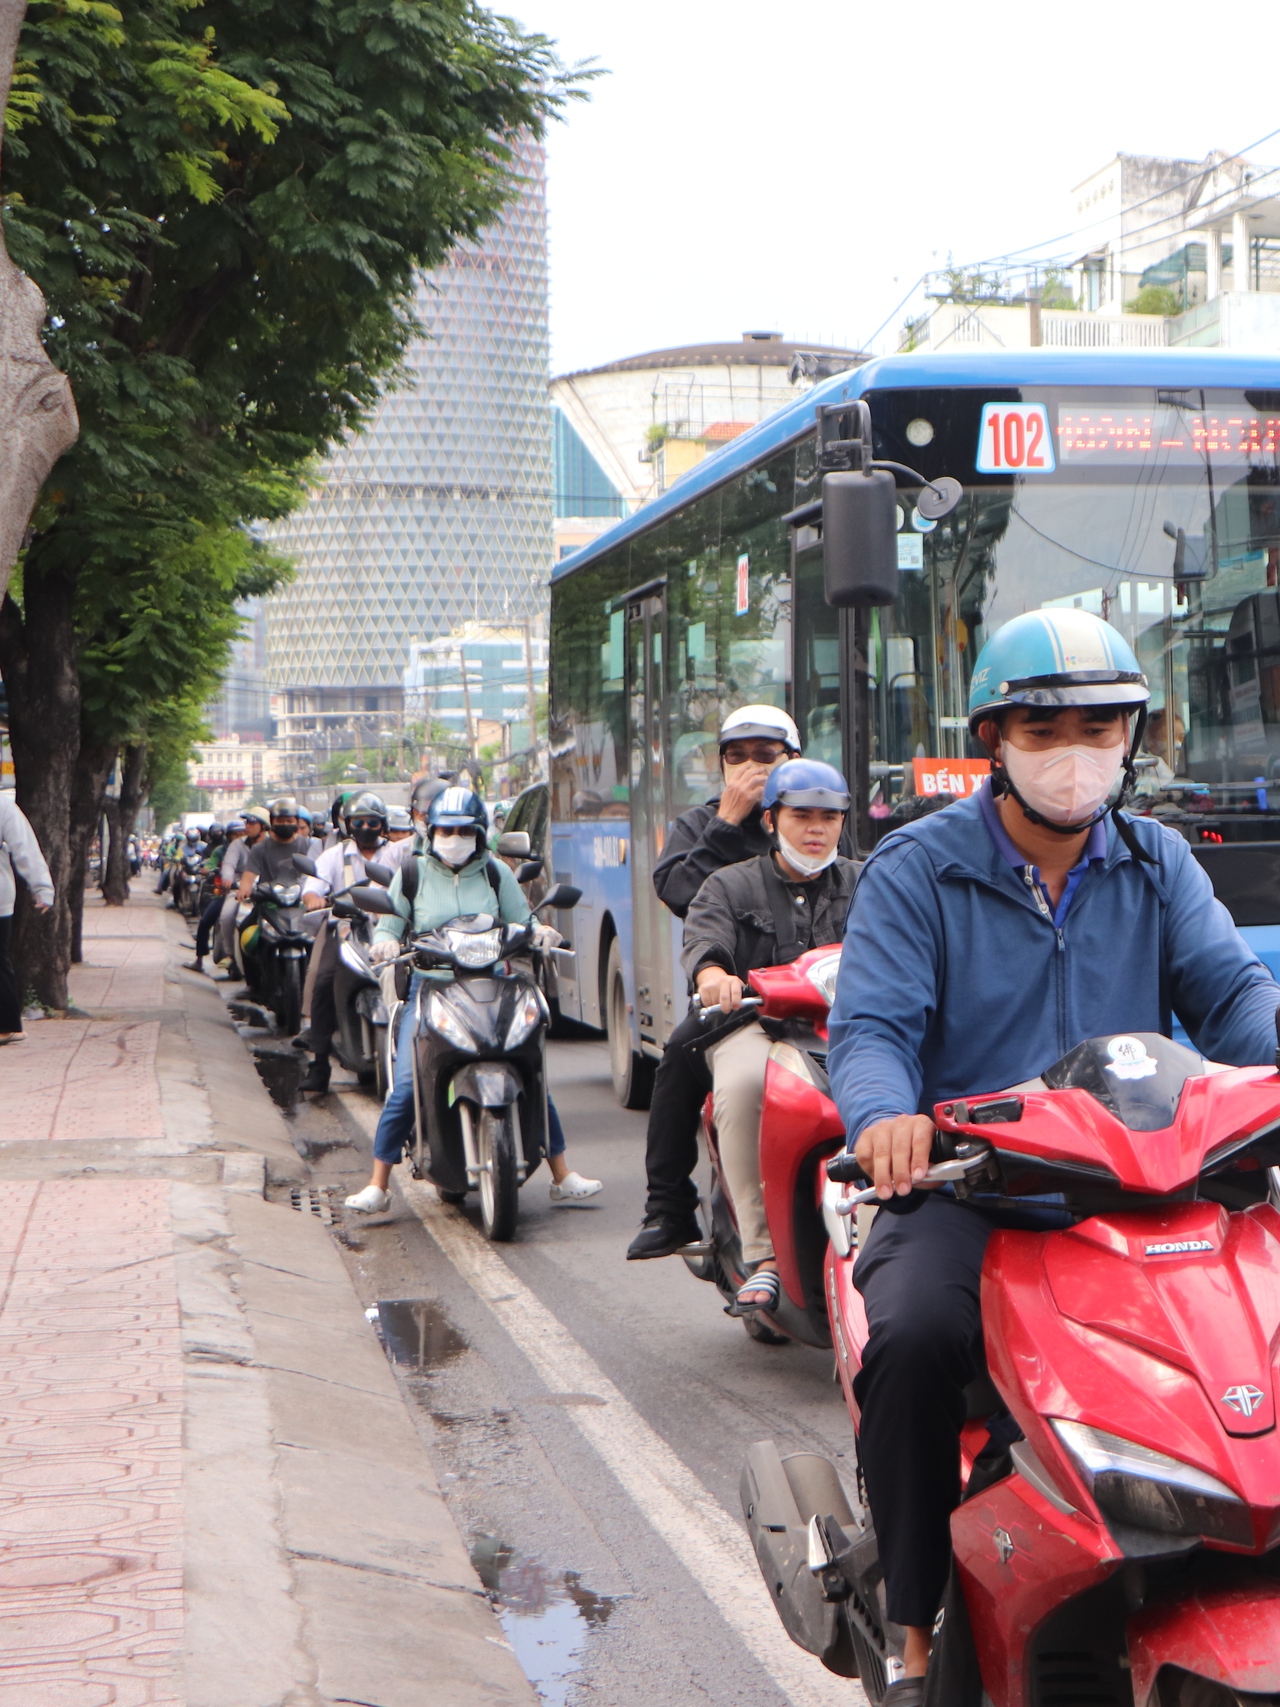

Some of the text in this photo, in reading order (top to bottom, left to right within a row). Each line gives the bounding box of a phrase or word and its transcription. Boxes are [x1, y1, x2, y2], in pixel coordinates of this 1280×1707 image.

[987, 412, 1045, 467] 102
[922, 767, 992, 794] BẾN X
[1145, 1240, 1215, 1256] HONDA
